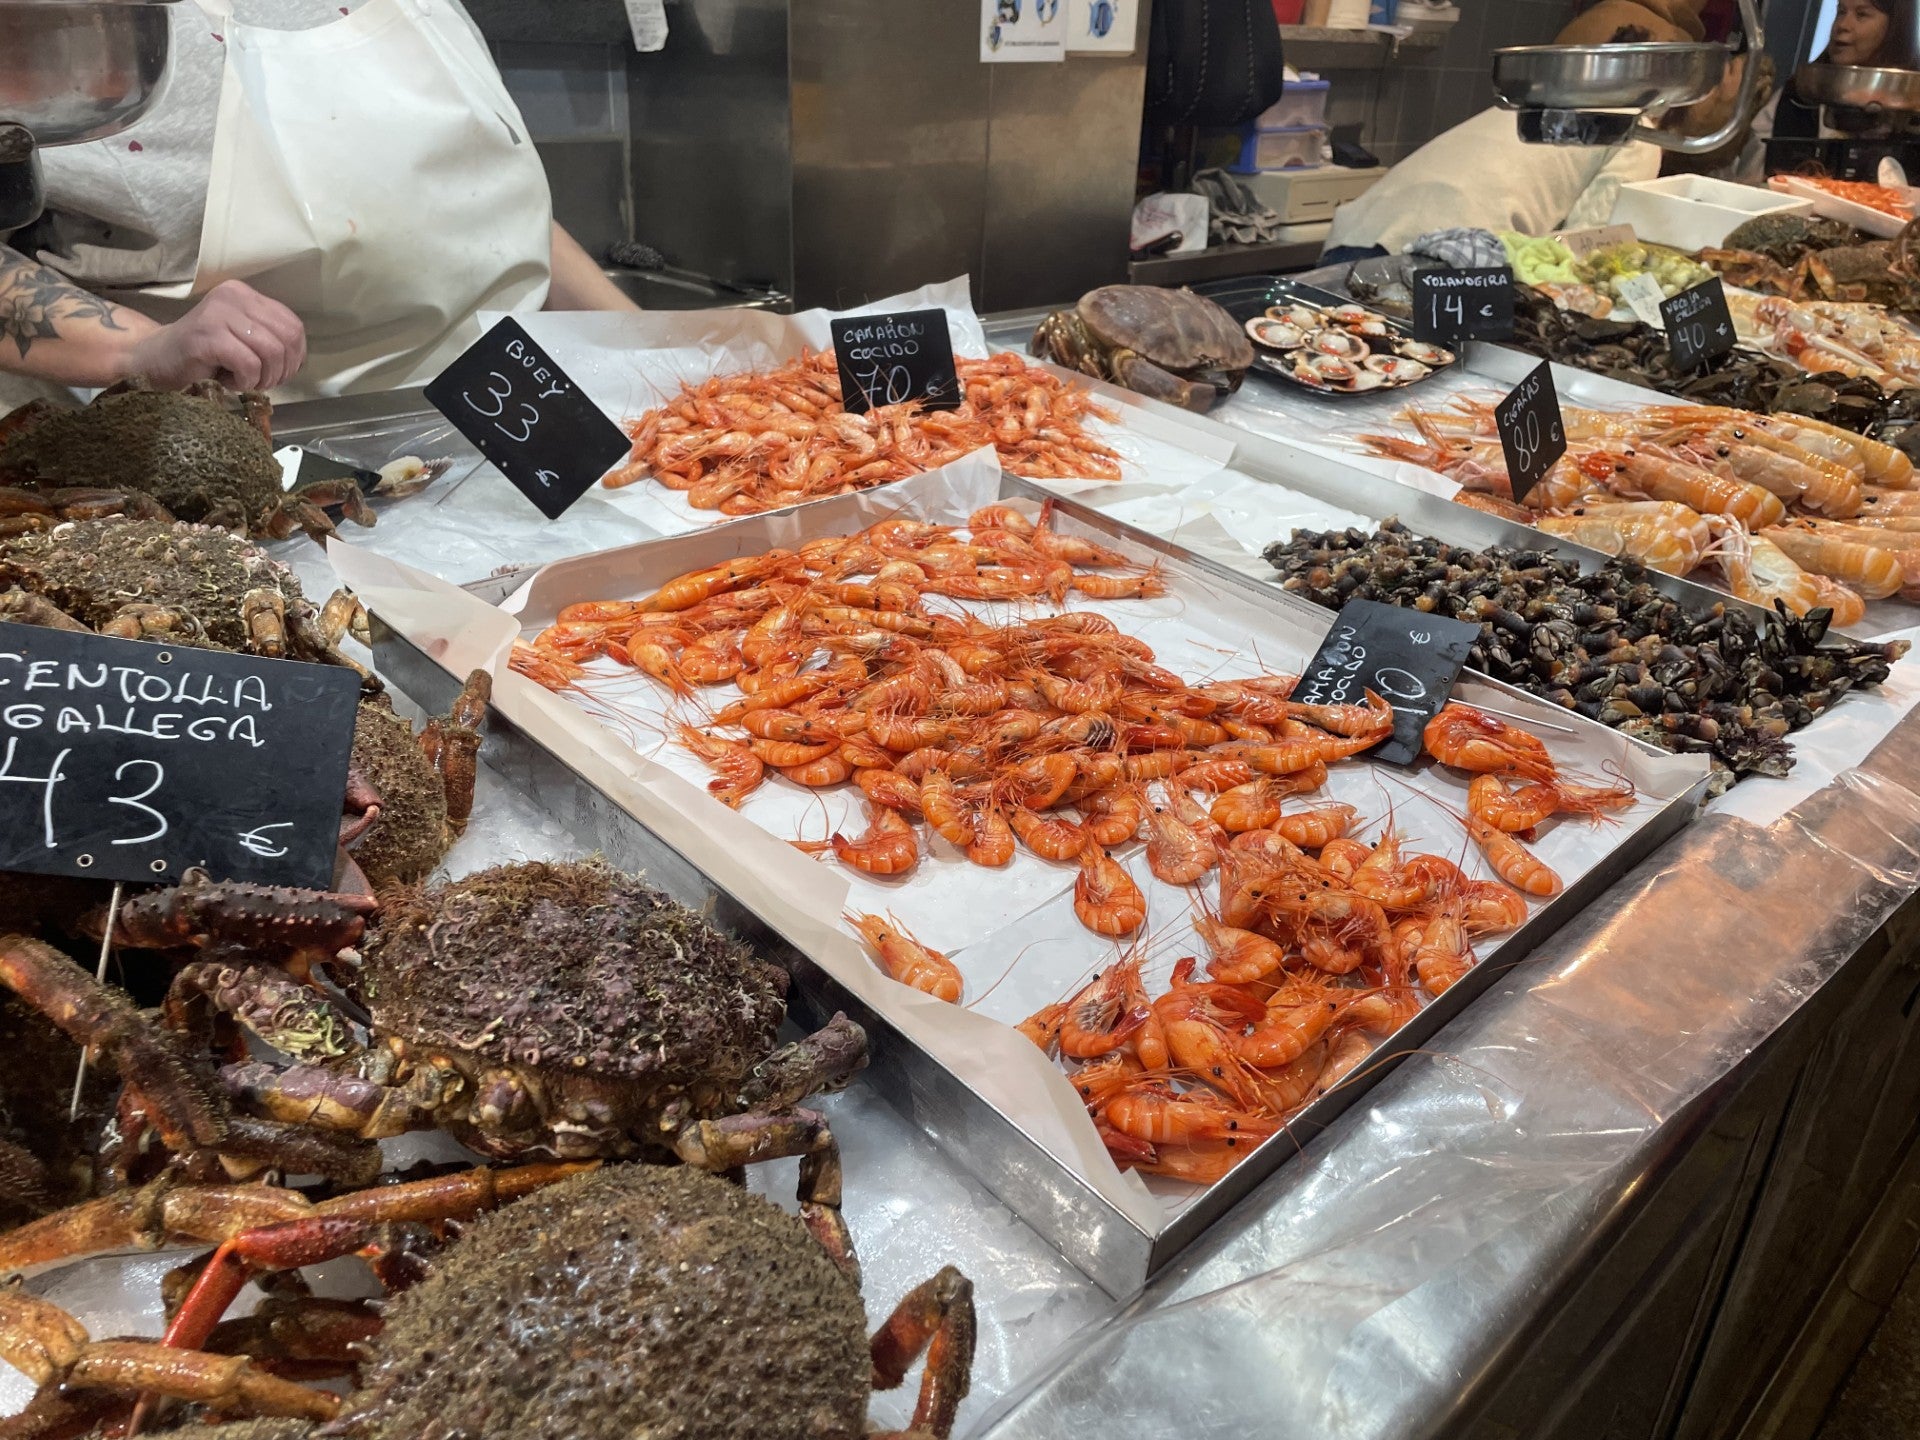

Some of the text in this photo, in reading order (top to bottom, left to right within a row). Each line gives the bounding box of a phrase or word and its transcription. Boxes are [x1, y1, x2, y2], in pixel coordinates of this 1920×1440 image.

[1431, 293, 1493, 329] 14 €
[850, 340, 919, 359] COCIDO
[1678, 322, 1705, 354] 40
[506, 340, 565, 399] BUEY
[855, 364, 911, 405] 70
[463, 371, 560, 488] 33 €
[1513, 410, 1540, 473] 80
[1409, 630, 1431, 645] €
[0, 653, 272, 711] CENTOLLA
[1303, 625, 1356, 706] AMAON
[4, 703, 265, 747] GALLEGA
[0, 737, 294, 857] 43 €
